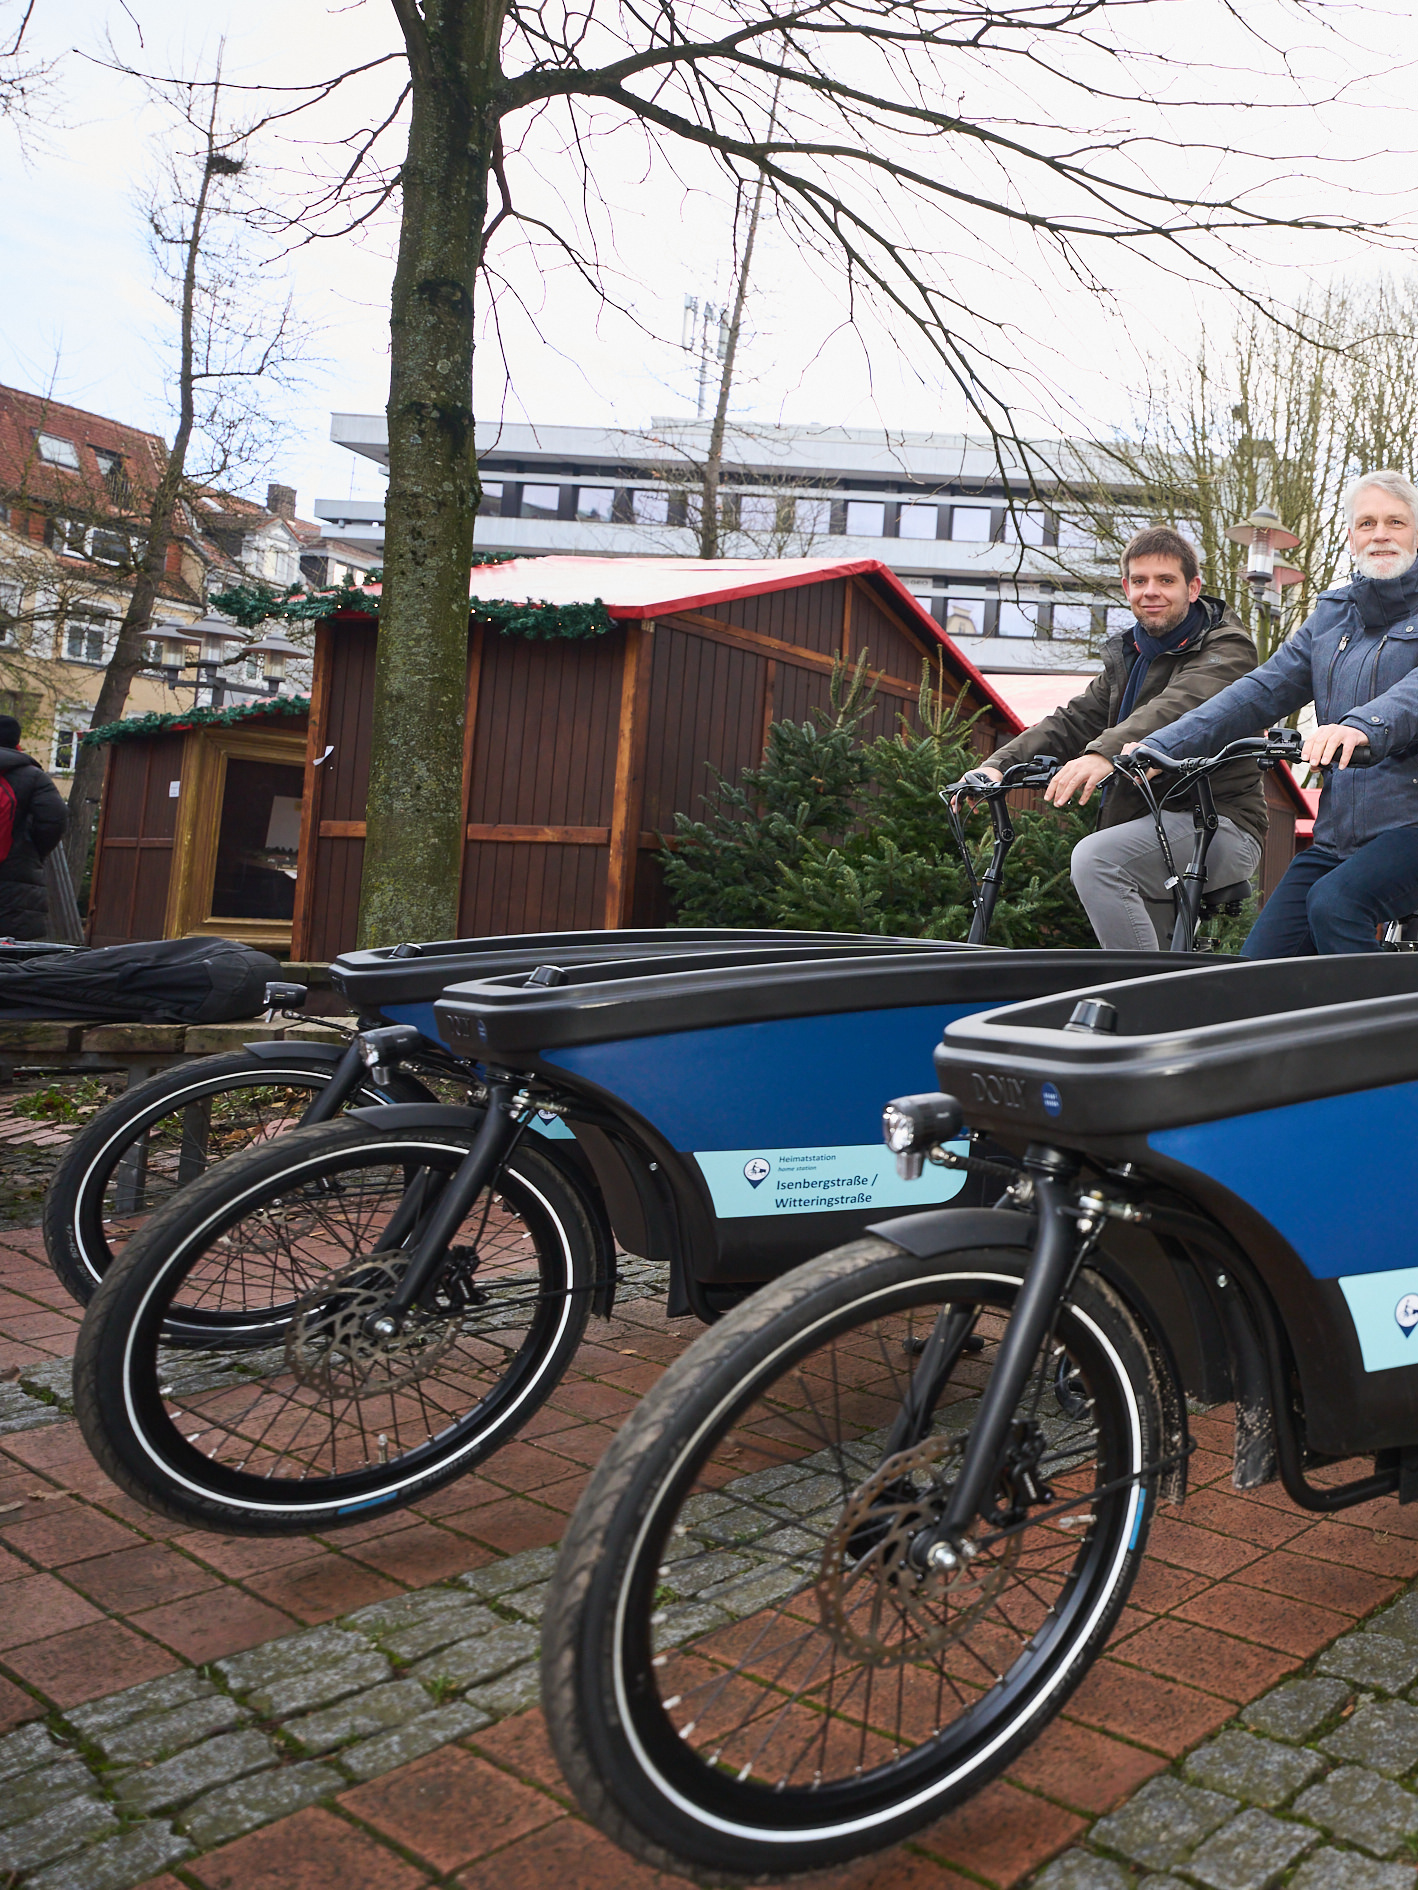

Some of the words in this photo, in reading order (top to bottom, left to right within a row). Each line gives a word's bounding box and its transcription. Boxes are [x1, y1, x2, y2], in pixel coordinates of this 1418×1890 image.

[779, 1154, 836, 1163] Heimatstation
[776, 1175, 868, 1190] Isenbergstraße
[871, 1173, 879, 1186] /
[775, 1192, 872, 1208] Witteringstraße
